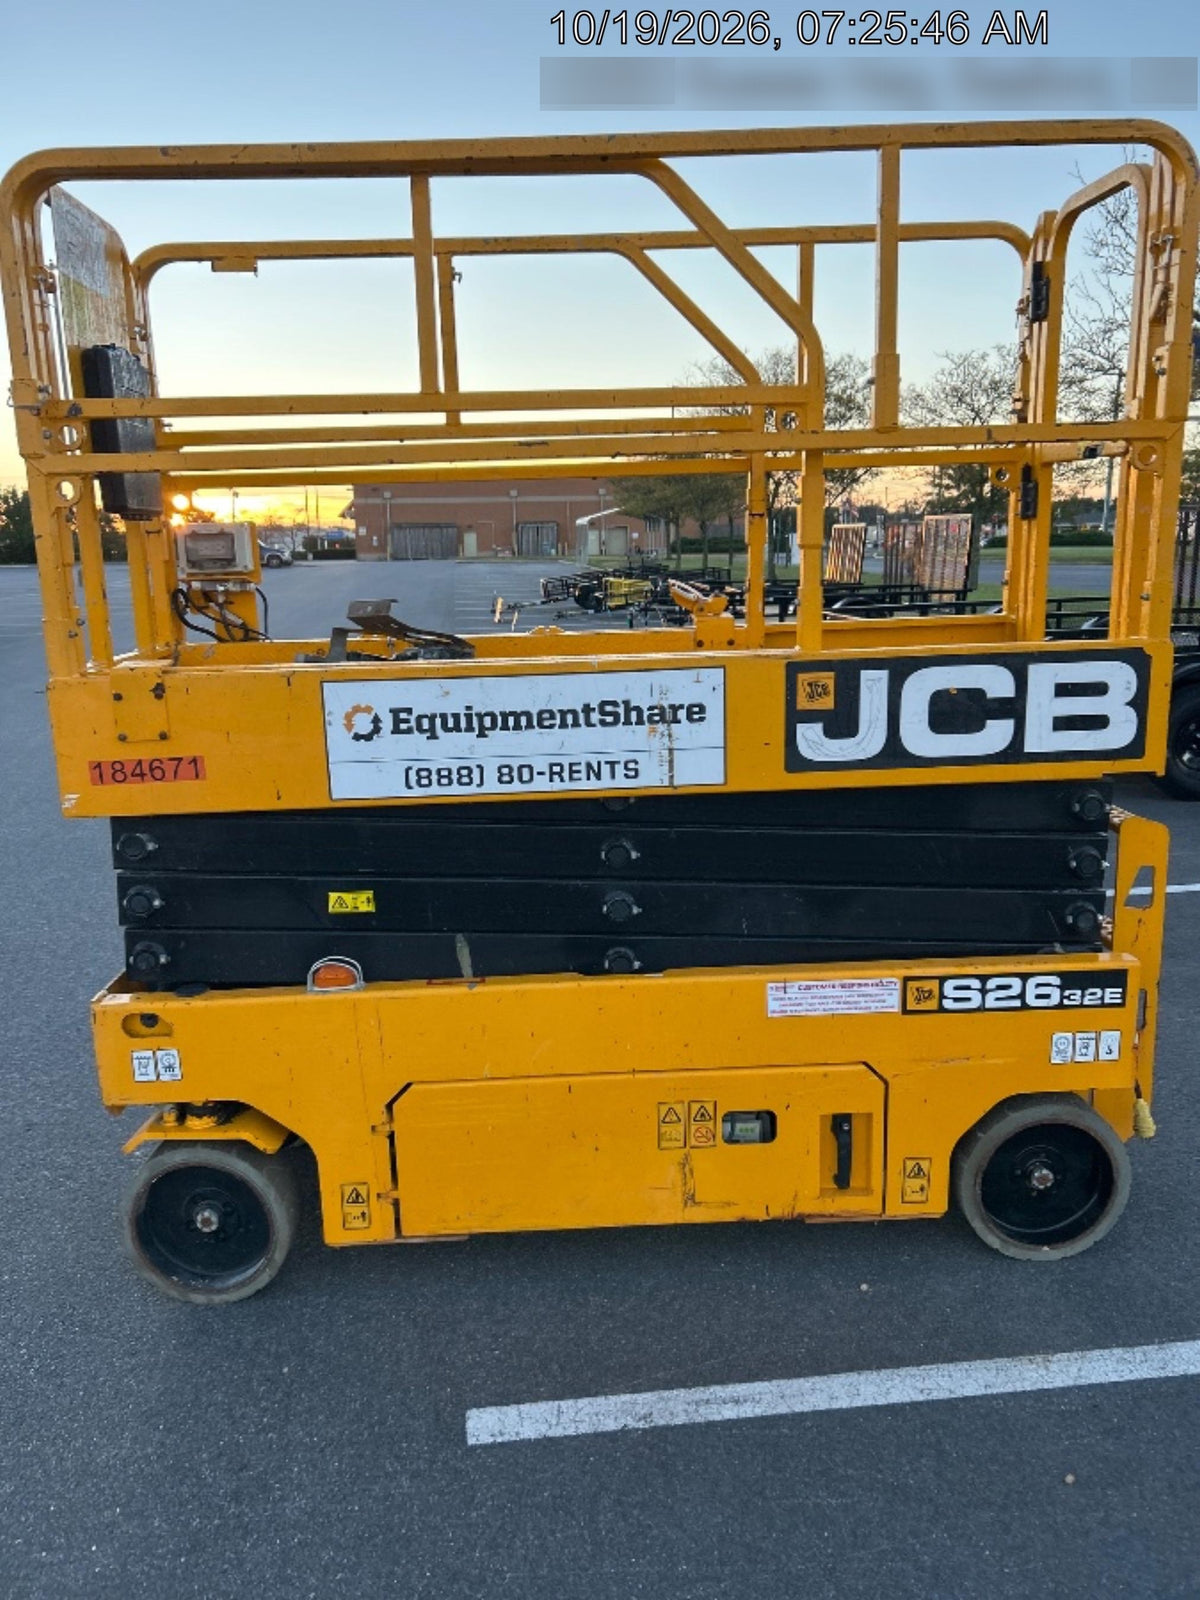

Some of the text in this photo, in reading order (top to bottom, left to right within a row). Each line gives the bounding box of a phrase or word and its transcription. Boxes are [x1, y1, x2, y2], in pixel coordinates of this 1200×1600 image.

[389, 699, 707, 740] EquipmentShare
[795, 660, 1138, 762] JCB
[91, 755, 203, 784] 184671
[404, 758, 640, 789] (888) 80-RENTS
[942, 975, 1123, 1010] S26 32E
